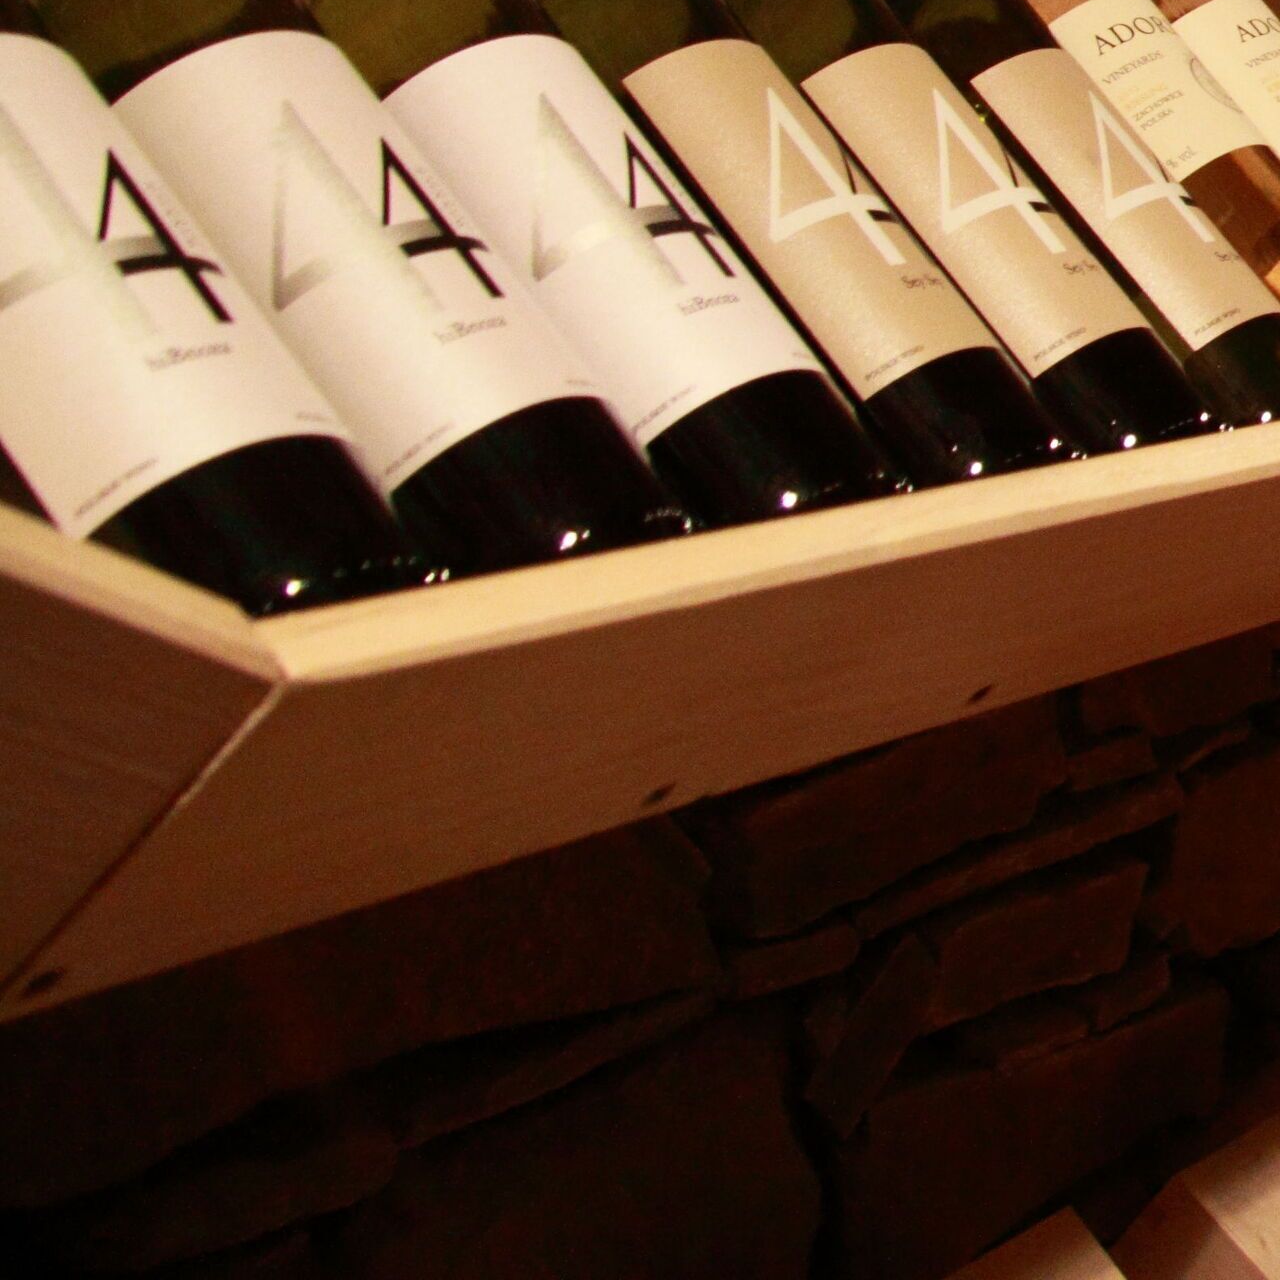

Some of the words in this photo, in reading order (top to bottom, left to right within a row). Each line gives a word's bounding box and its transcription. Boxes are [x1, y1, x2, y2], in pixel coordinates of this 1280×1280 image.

[1102, 50, 1165, 84] VINEYARDS
[1132, 90, 1184, 122] ZACHOWICE
[1139, 108, 1175, 131] POLSKA
